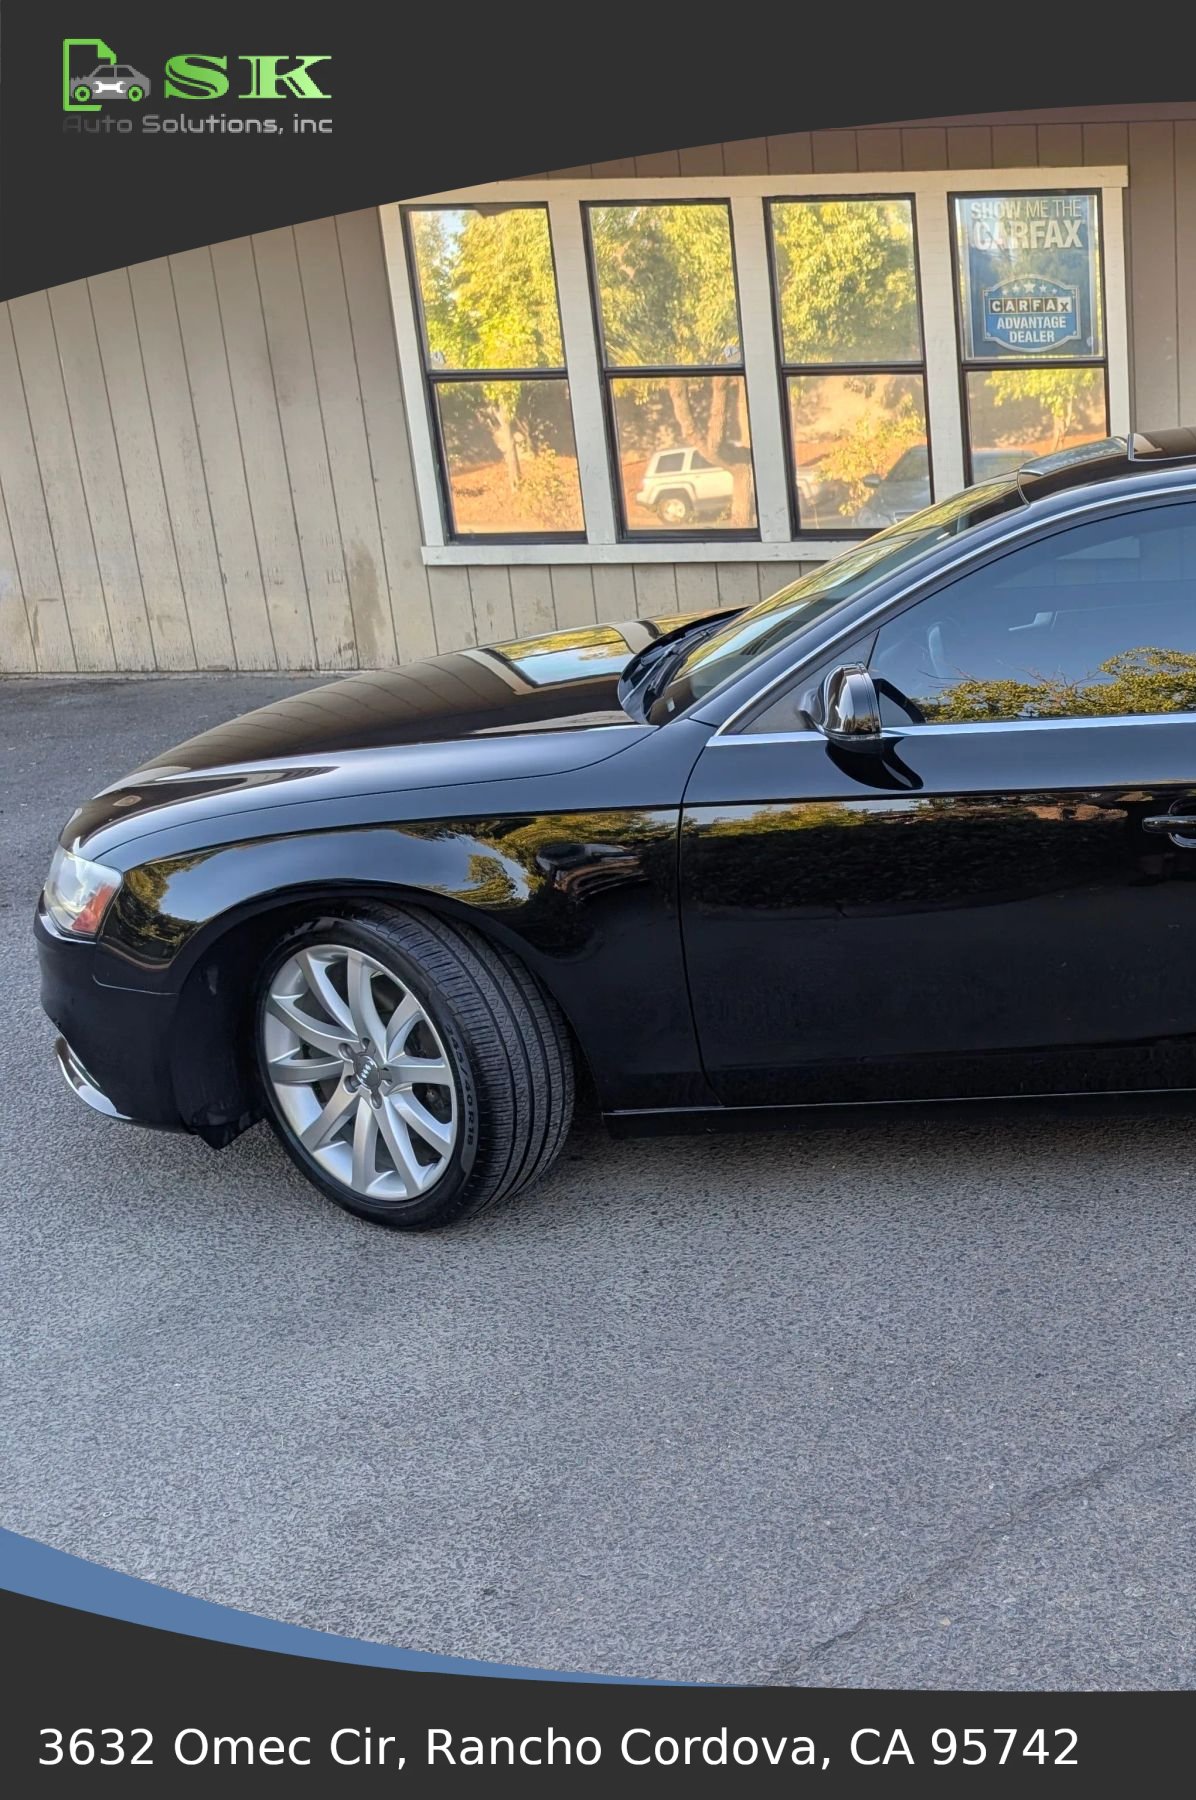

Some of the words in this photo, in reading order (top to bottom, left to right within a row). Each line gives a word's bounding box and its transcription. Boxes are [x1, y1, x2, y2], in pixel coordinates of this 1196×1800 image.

[971, 200, 1021, 220] SHOW
[1026, 200, 1049, 218] ME
[1053, 199, 1082, 218] THE
[973, 218, 1083, 250] CARFAX
[990, 300, 1070, 314] CARFAX
[997, 316, 1066, 330] ADVANTAGE
[1009, 330, 1055, 344] DEALER
